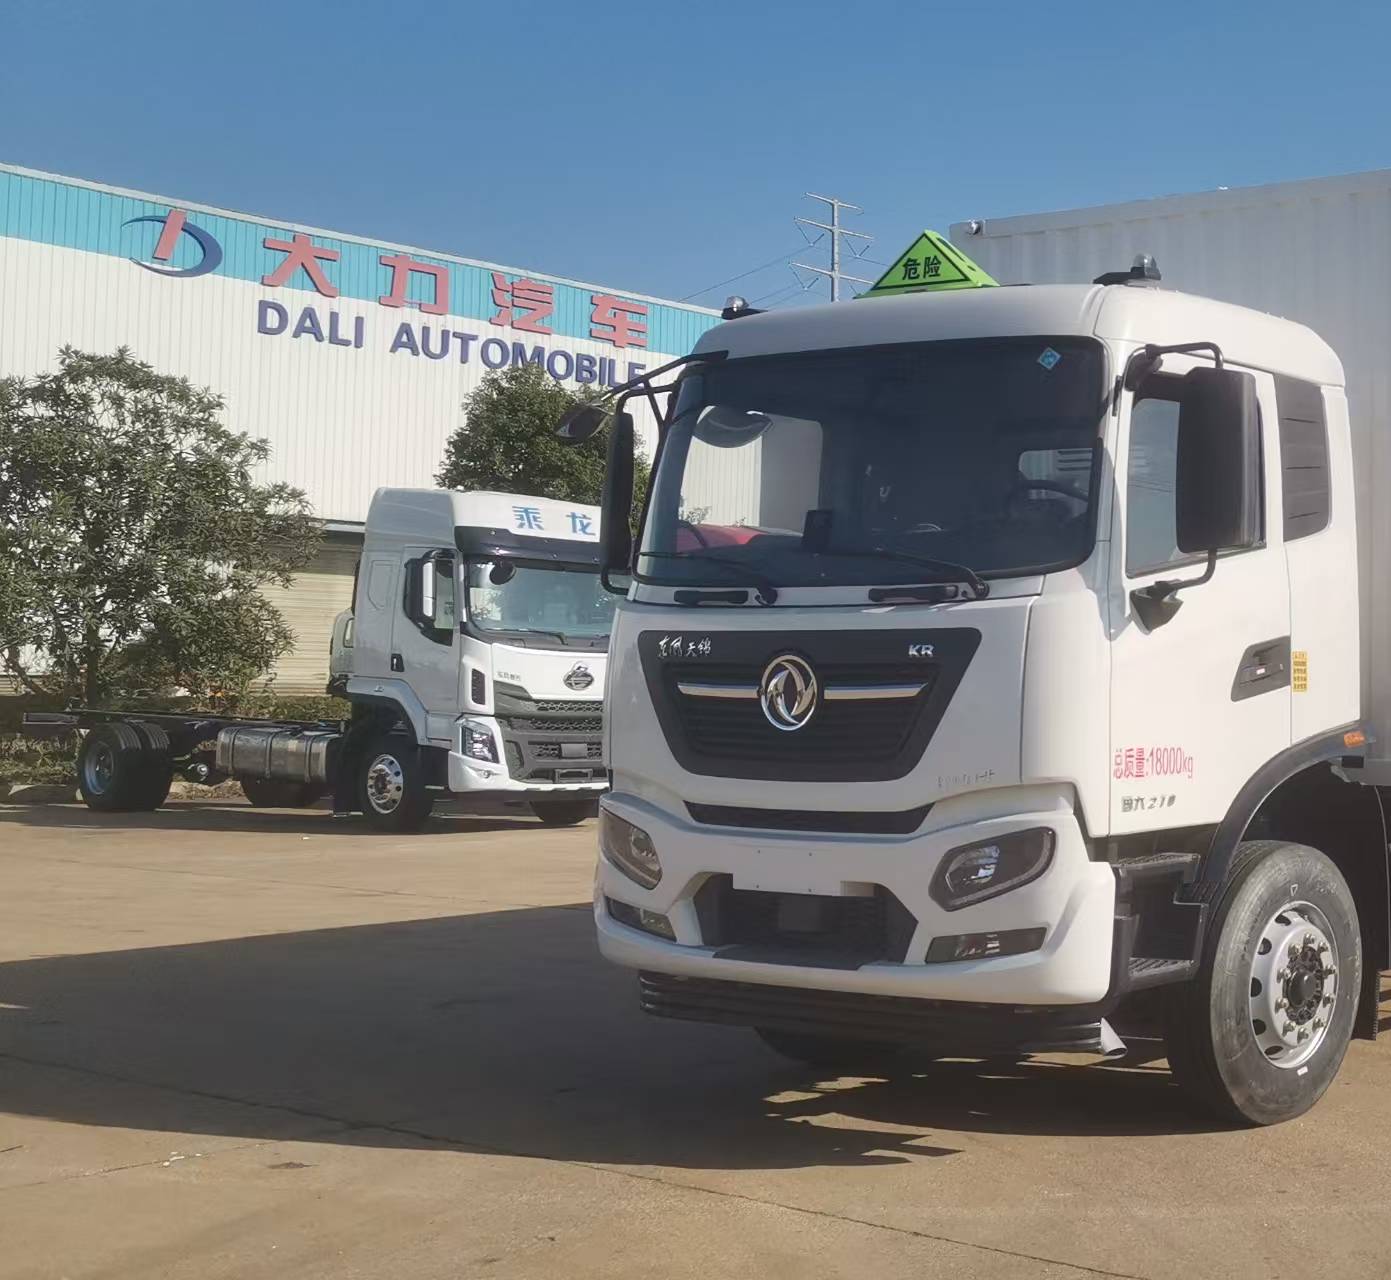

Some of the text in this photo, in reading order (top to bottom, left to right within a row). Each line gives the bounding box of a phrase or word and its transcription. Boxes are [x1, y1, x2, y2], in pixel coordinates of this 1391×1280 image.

[902, 255, 942, 280] 危险
[262, 233, 649, 349] 大力汽车
[257, 299, 365, 349] DALI
[512, 505, 596, 536] 乘龙
[908, 644, 934, 657] KR
